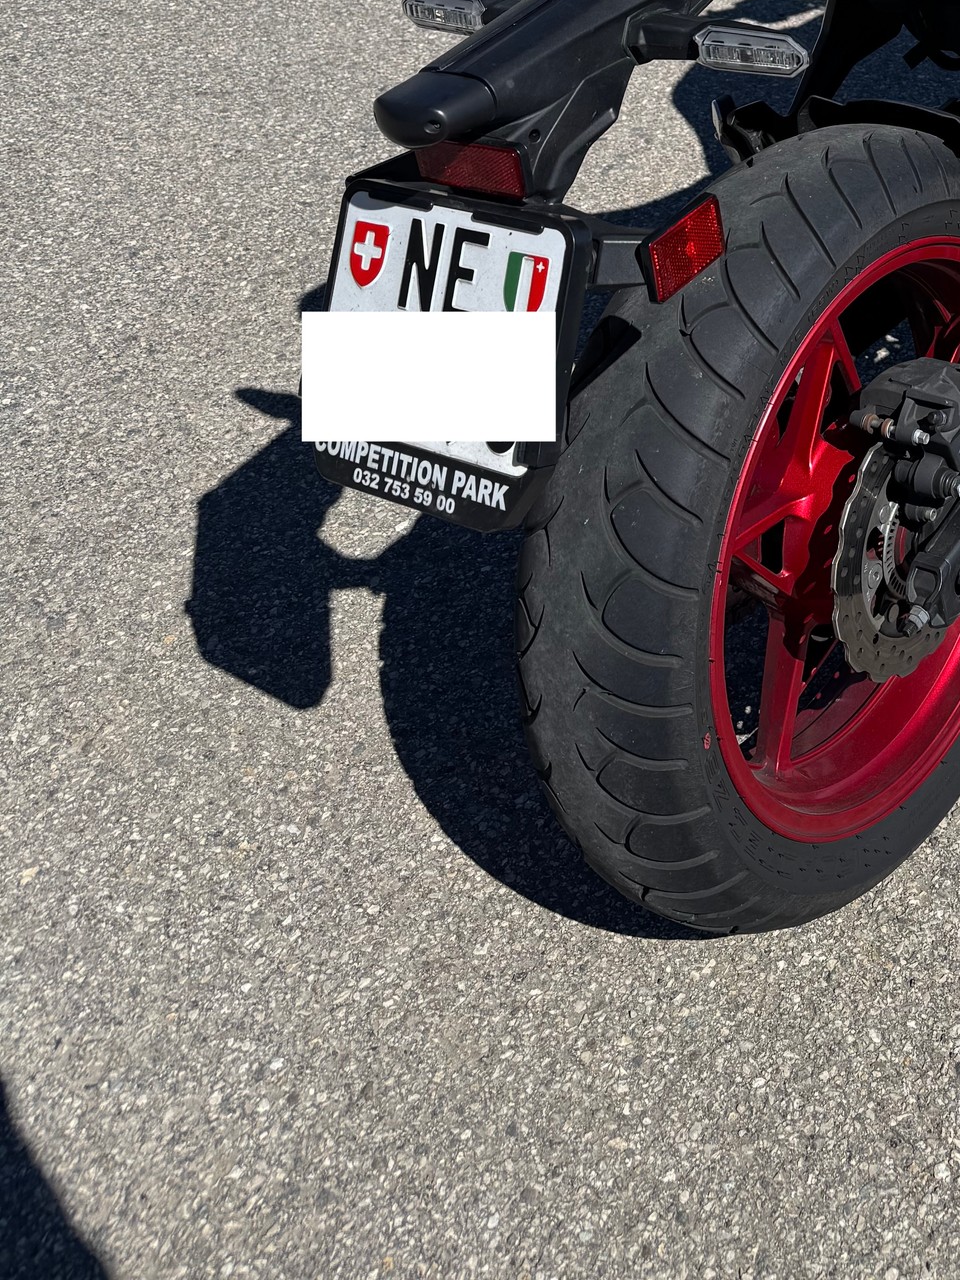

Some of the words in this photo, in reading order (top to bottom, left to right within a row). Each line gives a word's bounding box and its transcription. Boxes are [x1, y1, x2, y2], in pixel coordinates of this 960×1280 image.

[398, 218, 491, 312] NE
[352, 467, 380, 490] 032
[383, 478, 411, 500] 753
[413, 488, 433, 507] 59
[436, 495, 456, 515] 00
[451, 470, 510, 511] PARK
